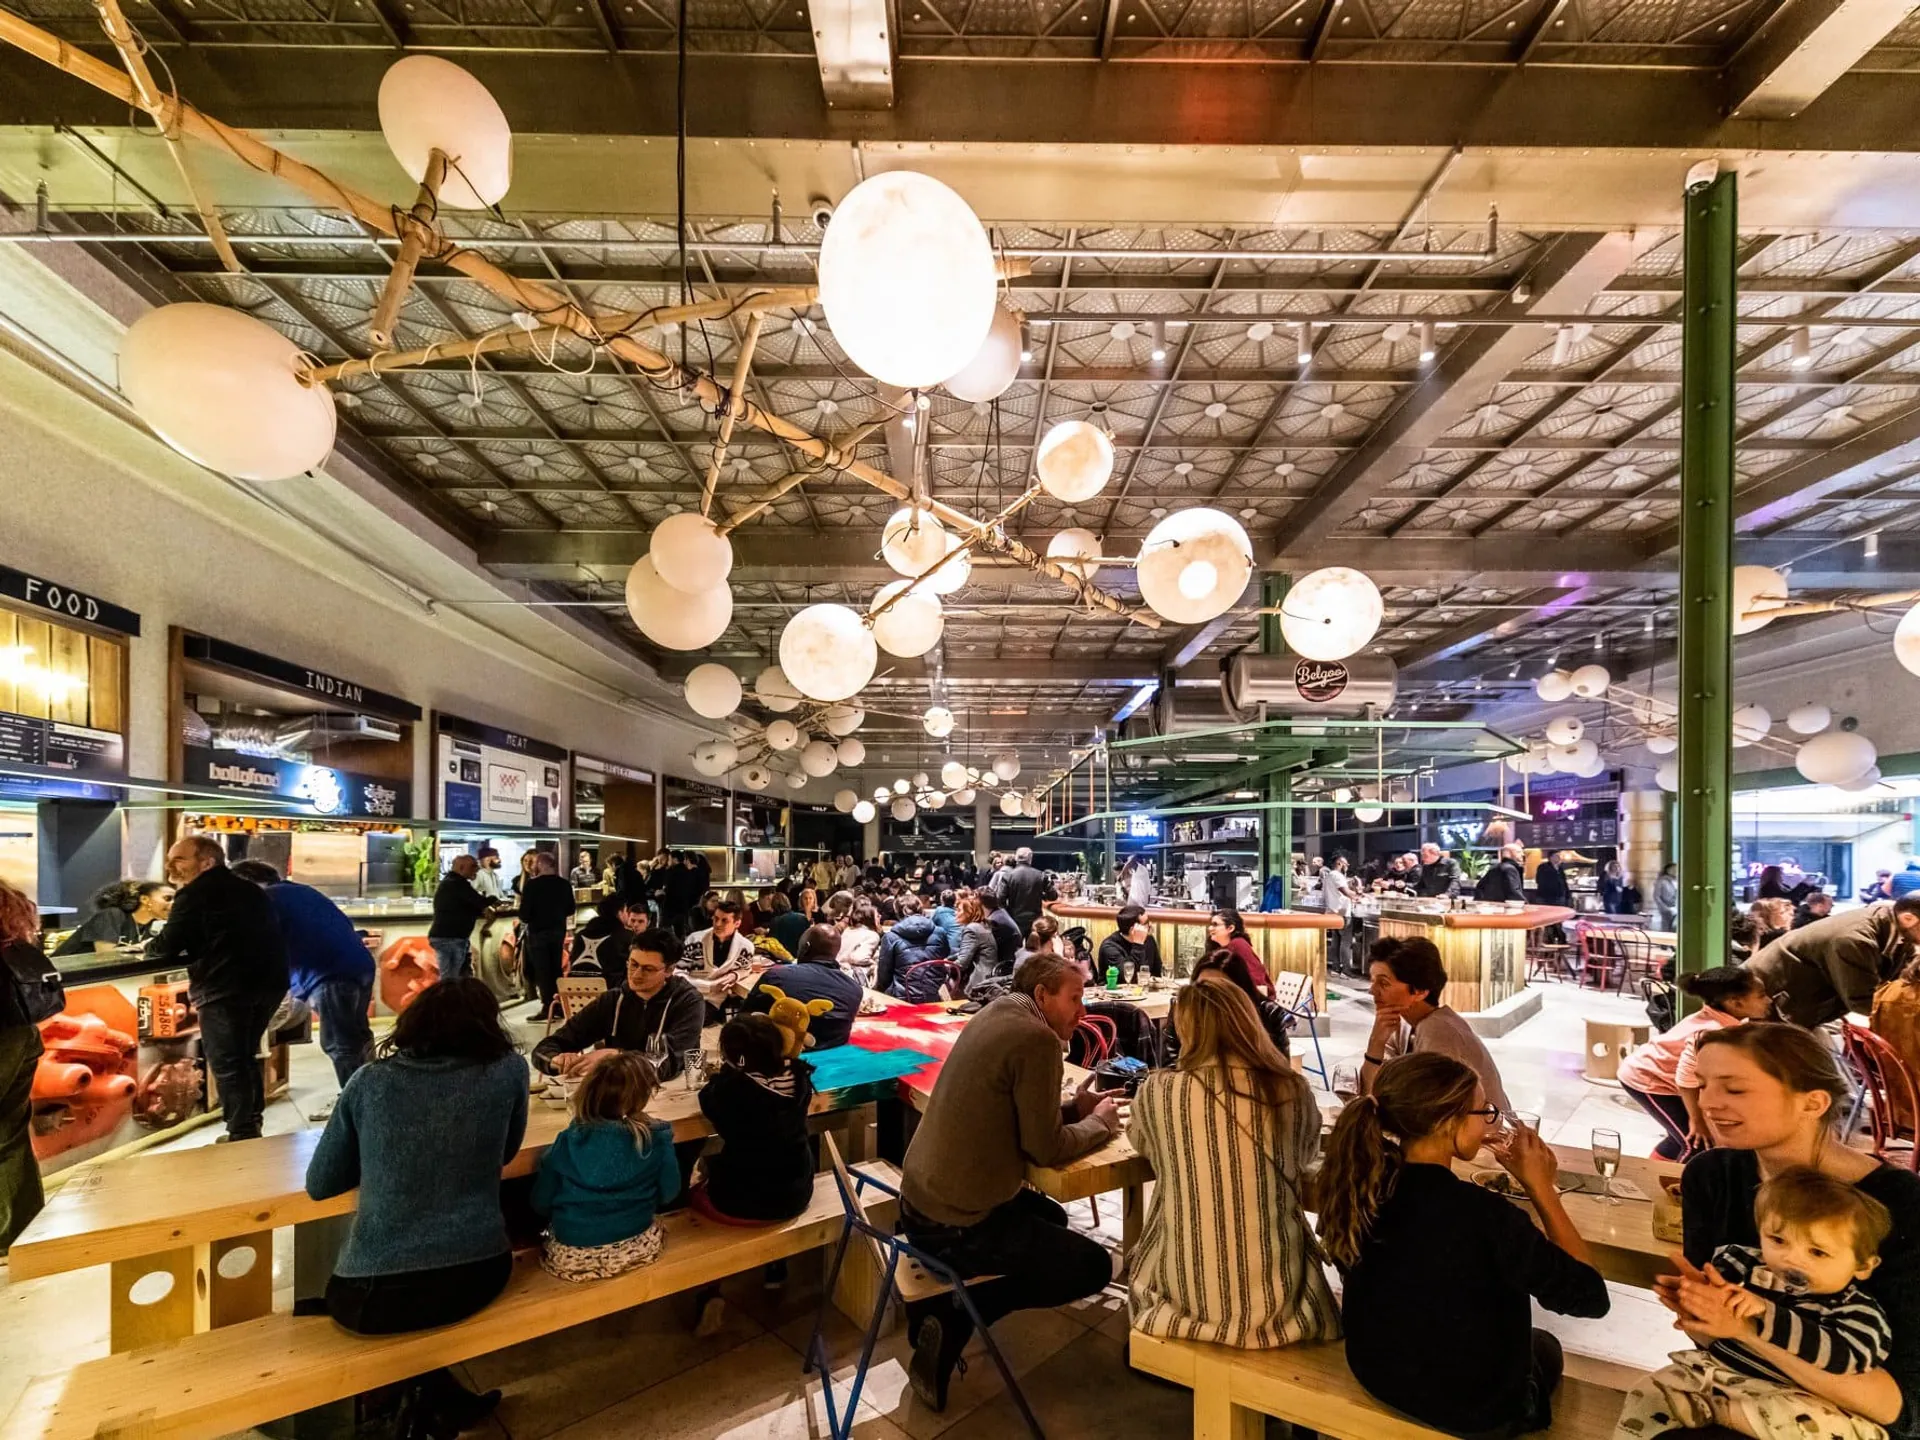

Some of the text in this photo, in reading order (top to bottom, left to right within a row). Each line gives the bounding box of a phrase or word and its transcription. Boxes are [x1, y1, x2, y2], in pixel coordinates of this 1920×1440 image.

[25, 578, 99, 621] FOOD
[305, 671, 363, 703] INDIAN
[1296, 664, 1346, 688] Belgoo
[505, 734, 529, 749] MEAT
